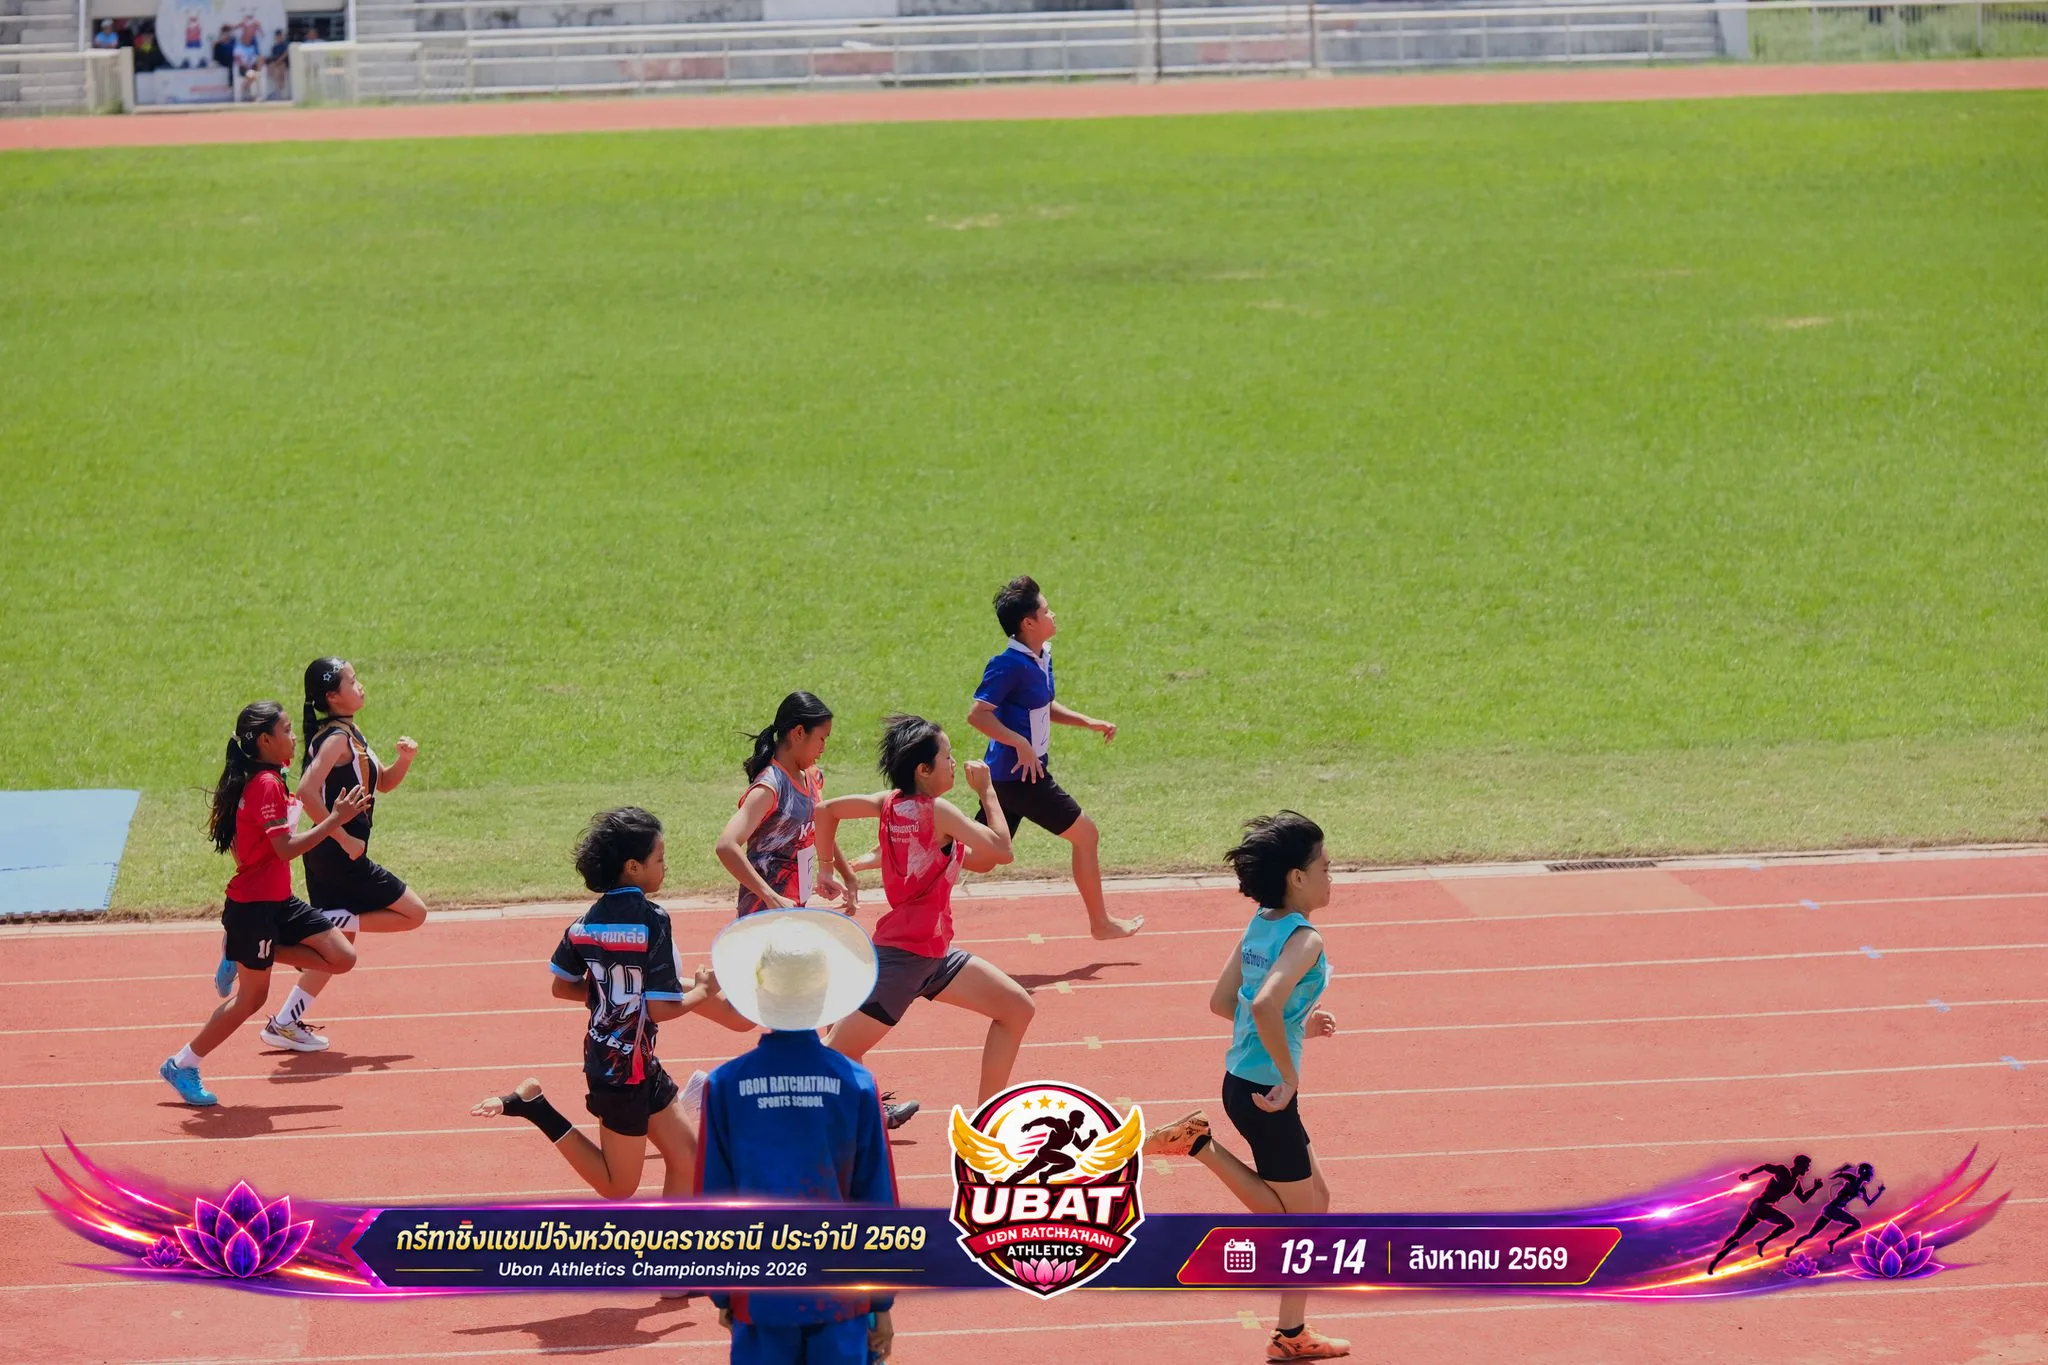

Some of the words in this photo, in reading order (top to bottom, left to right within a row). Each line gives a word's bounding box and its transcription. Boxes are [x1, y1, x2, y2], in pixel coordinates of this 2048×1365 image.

[739, 1077, 768, 1096] UBON
[769, 1076, 841, 1095] RATCHATHANI
[757, 1095, 790, 1109] SPORTS
[791, 1095, 824, 1108] SCHOOL
